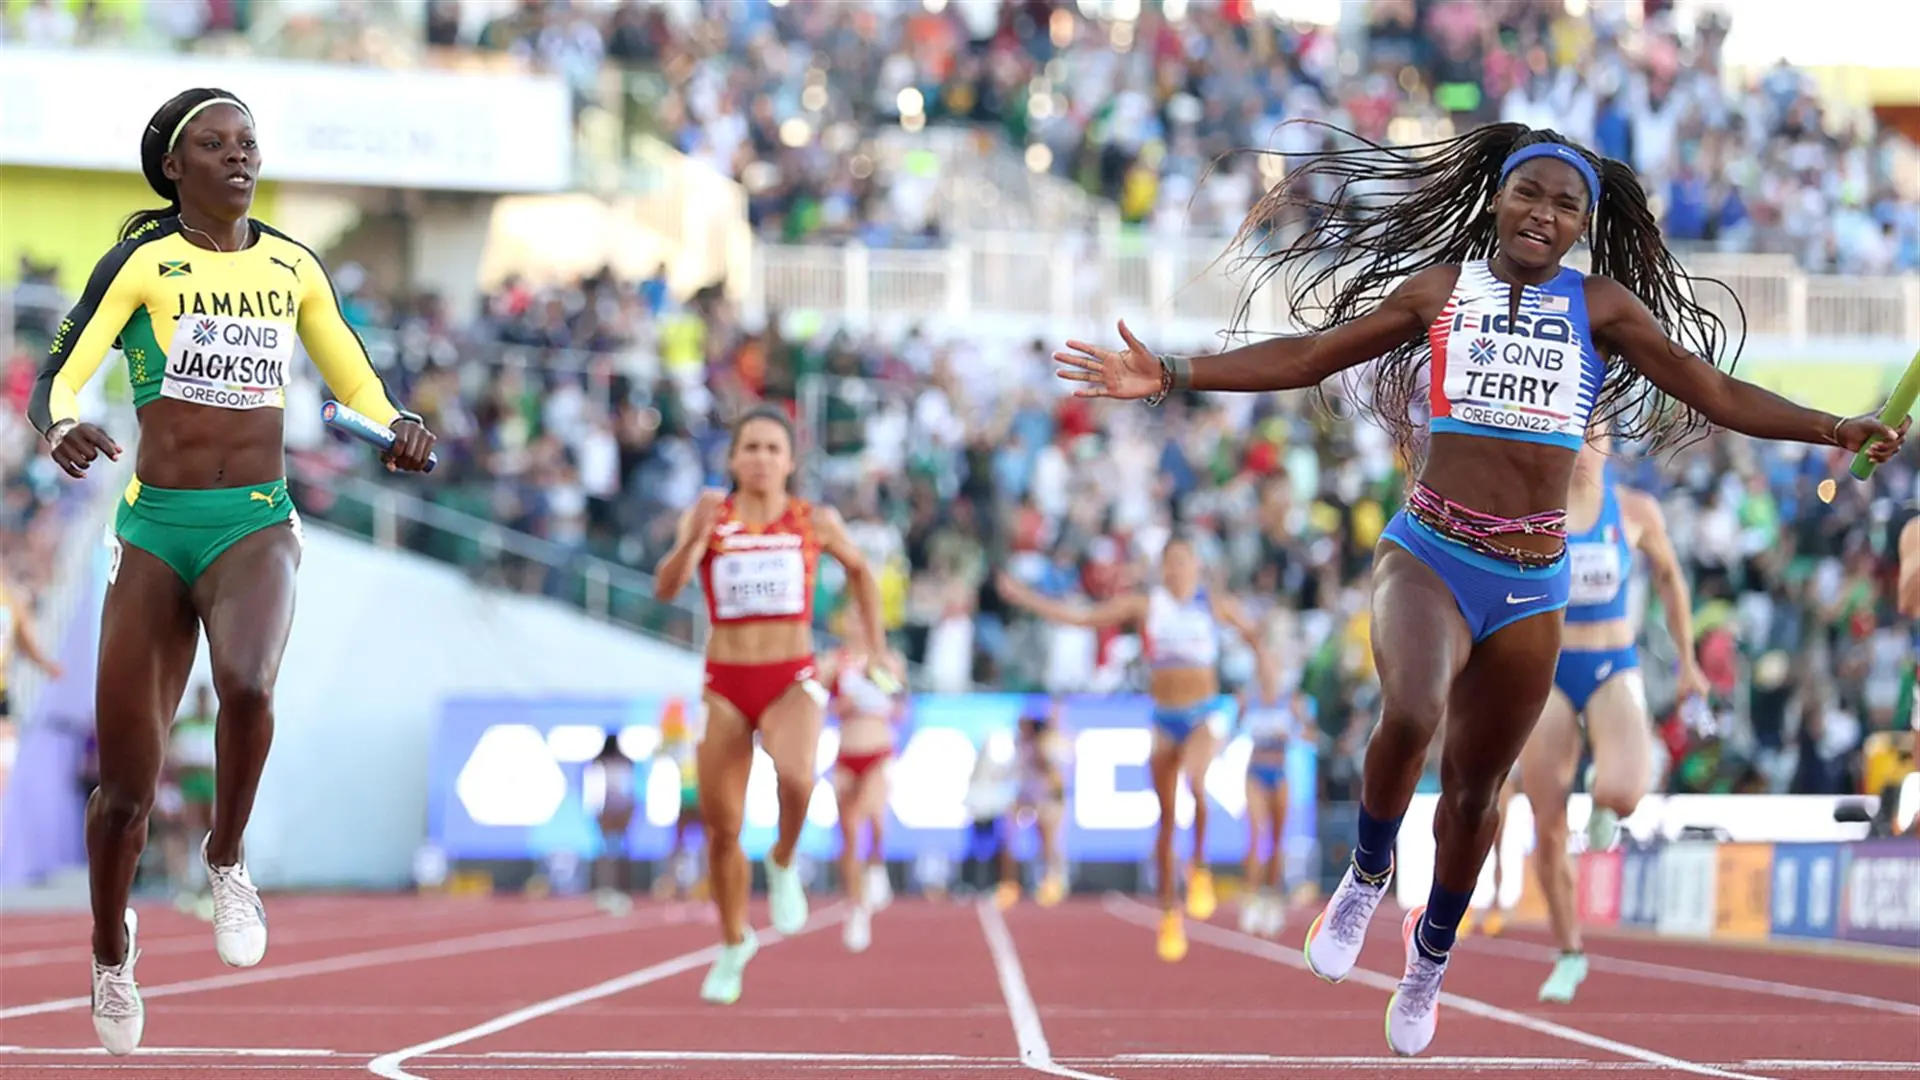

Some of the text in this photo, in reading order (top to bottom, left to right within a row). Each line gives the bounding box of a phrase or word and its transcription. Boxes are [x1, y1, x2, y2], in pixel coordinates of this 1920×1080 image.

[173, 290, 295, 320] JAMAICA
[223, 323, 278, 349] QNB
[173, 350, 283, 386] JACKSON
[1503, 343, 1564, 371] QNB
[1466, 371, 1559, 406] TERRY
[1463, 407, 1550, 431] OREGON22
